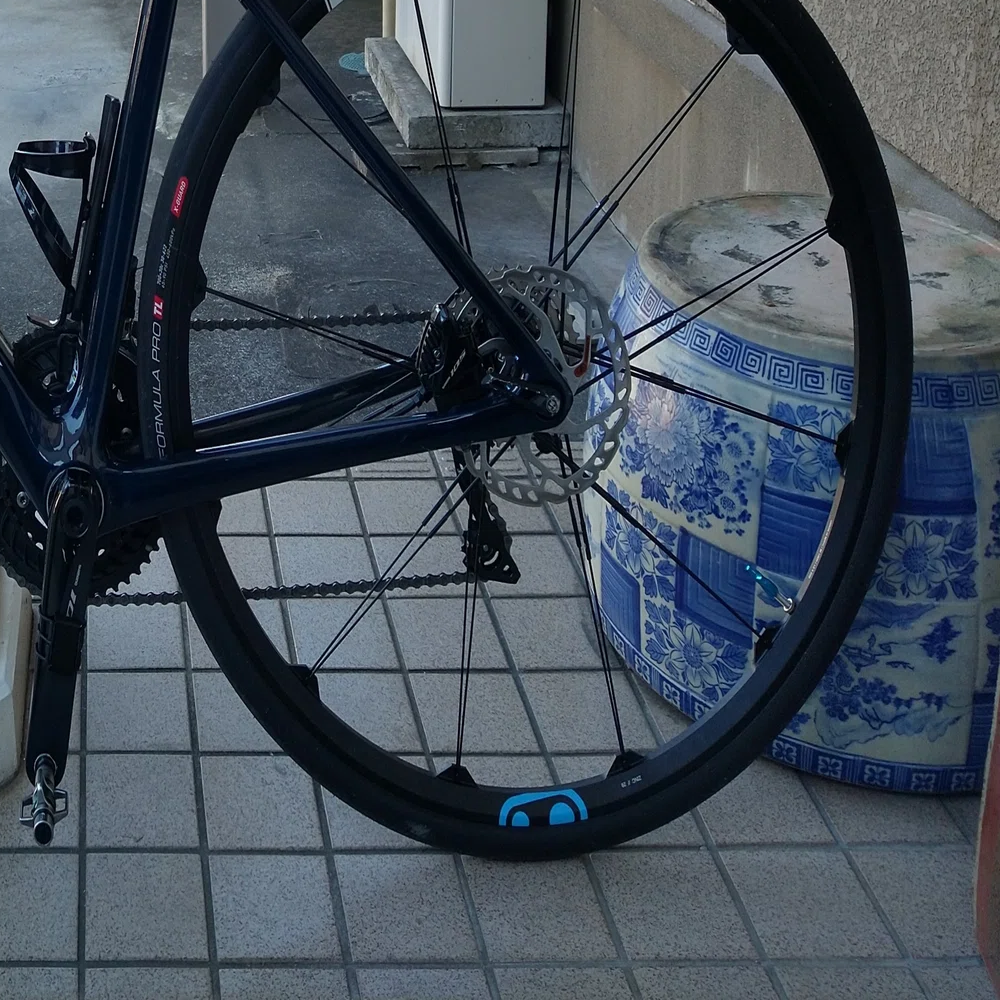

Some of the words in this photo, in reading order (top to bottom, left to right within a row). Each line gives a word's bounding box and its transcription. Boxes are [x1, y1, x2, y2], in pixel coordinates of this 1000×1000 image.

[173, 180, 186, 214] X-GUARD
[153, 300, 164, 316] TL
[152, 321, 162, 363] PRO
